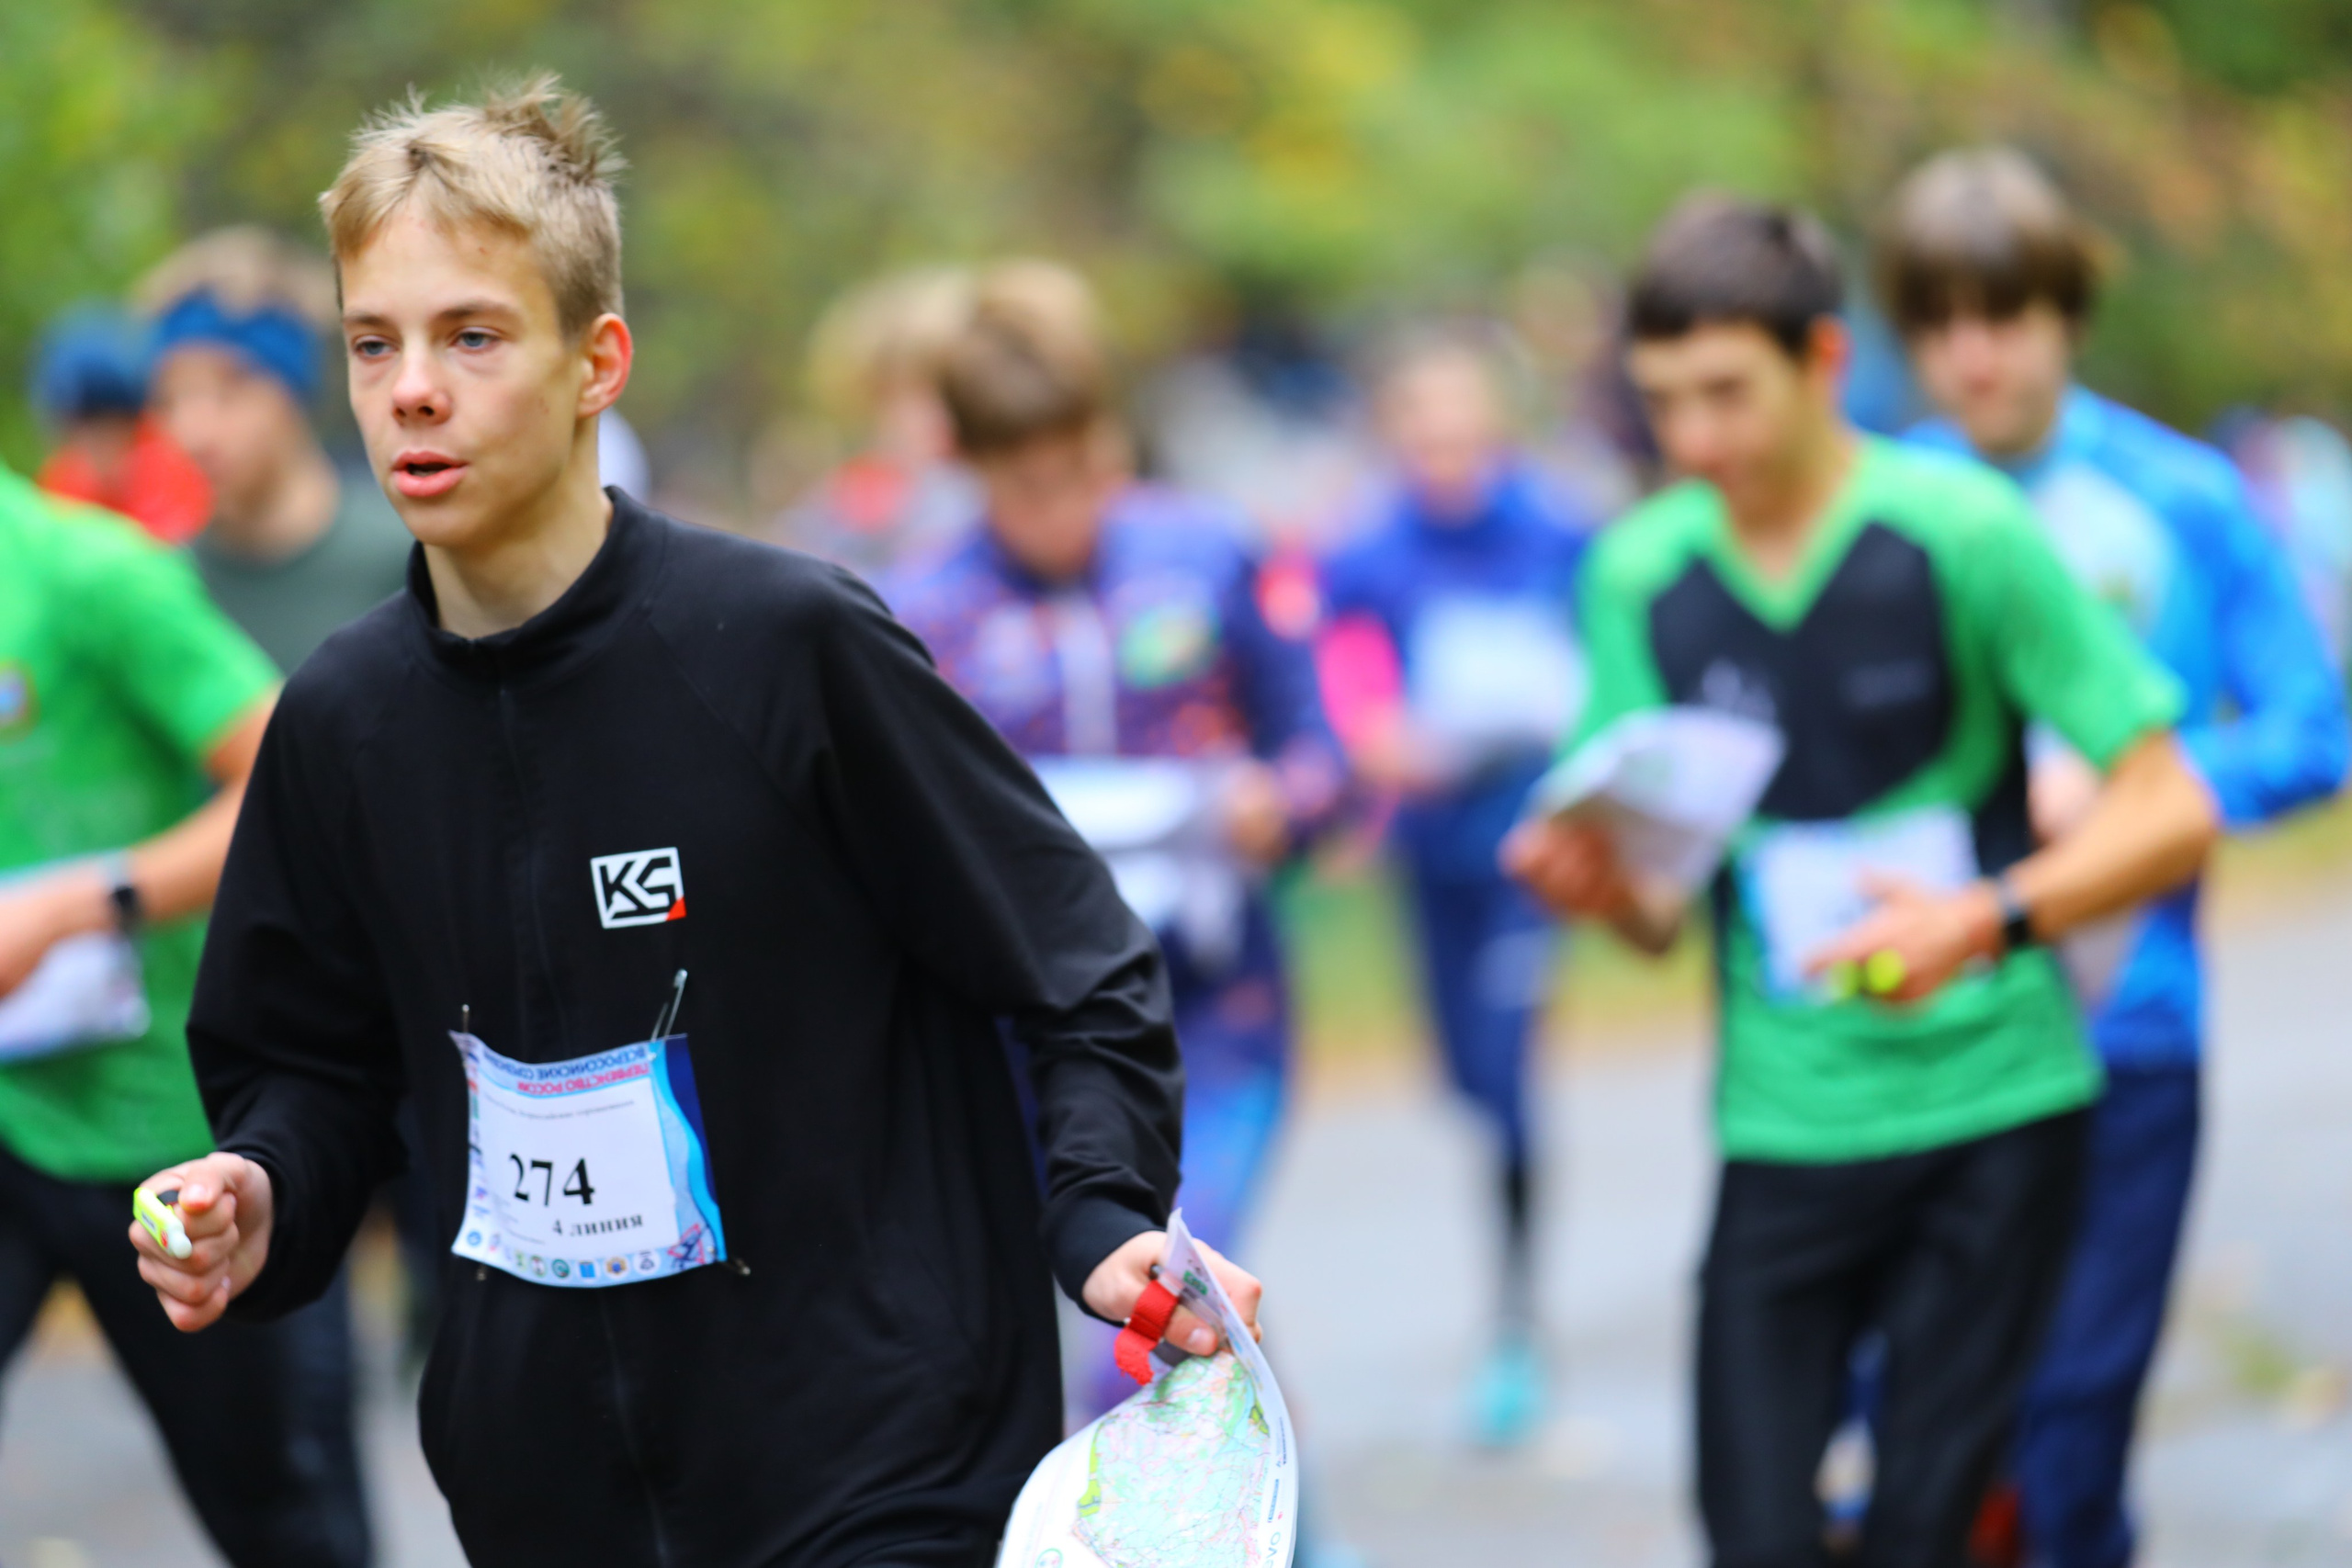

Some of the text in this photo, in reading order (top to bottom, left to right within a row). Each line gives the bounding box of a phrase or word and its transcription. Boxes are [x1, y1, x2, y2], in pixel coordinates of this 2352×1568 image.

[565, 1063, 650, 1092] ПЕРВЕНСТВО
[509, 1152, 595, 1207] 274
[552, 1218, 564, 1236] 4
[570, 1214, 643, 1236] линия
